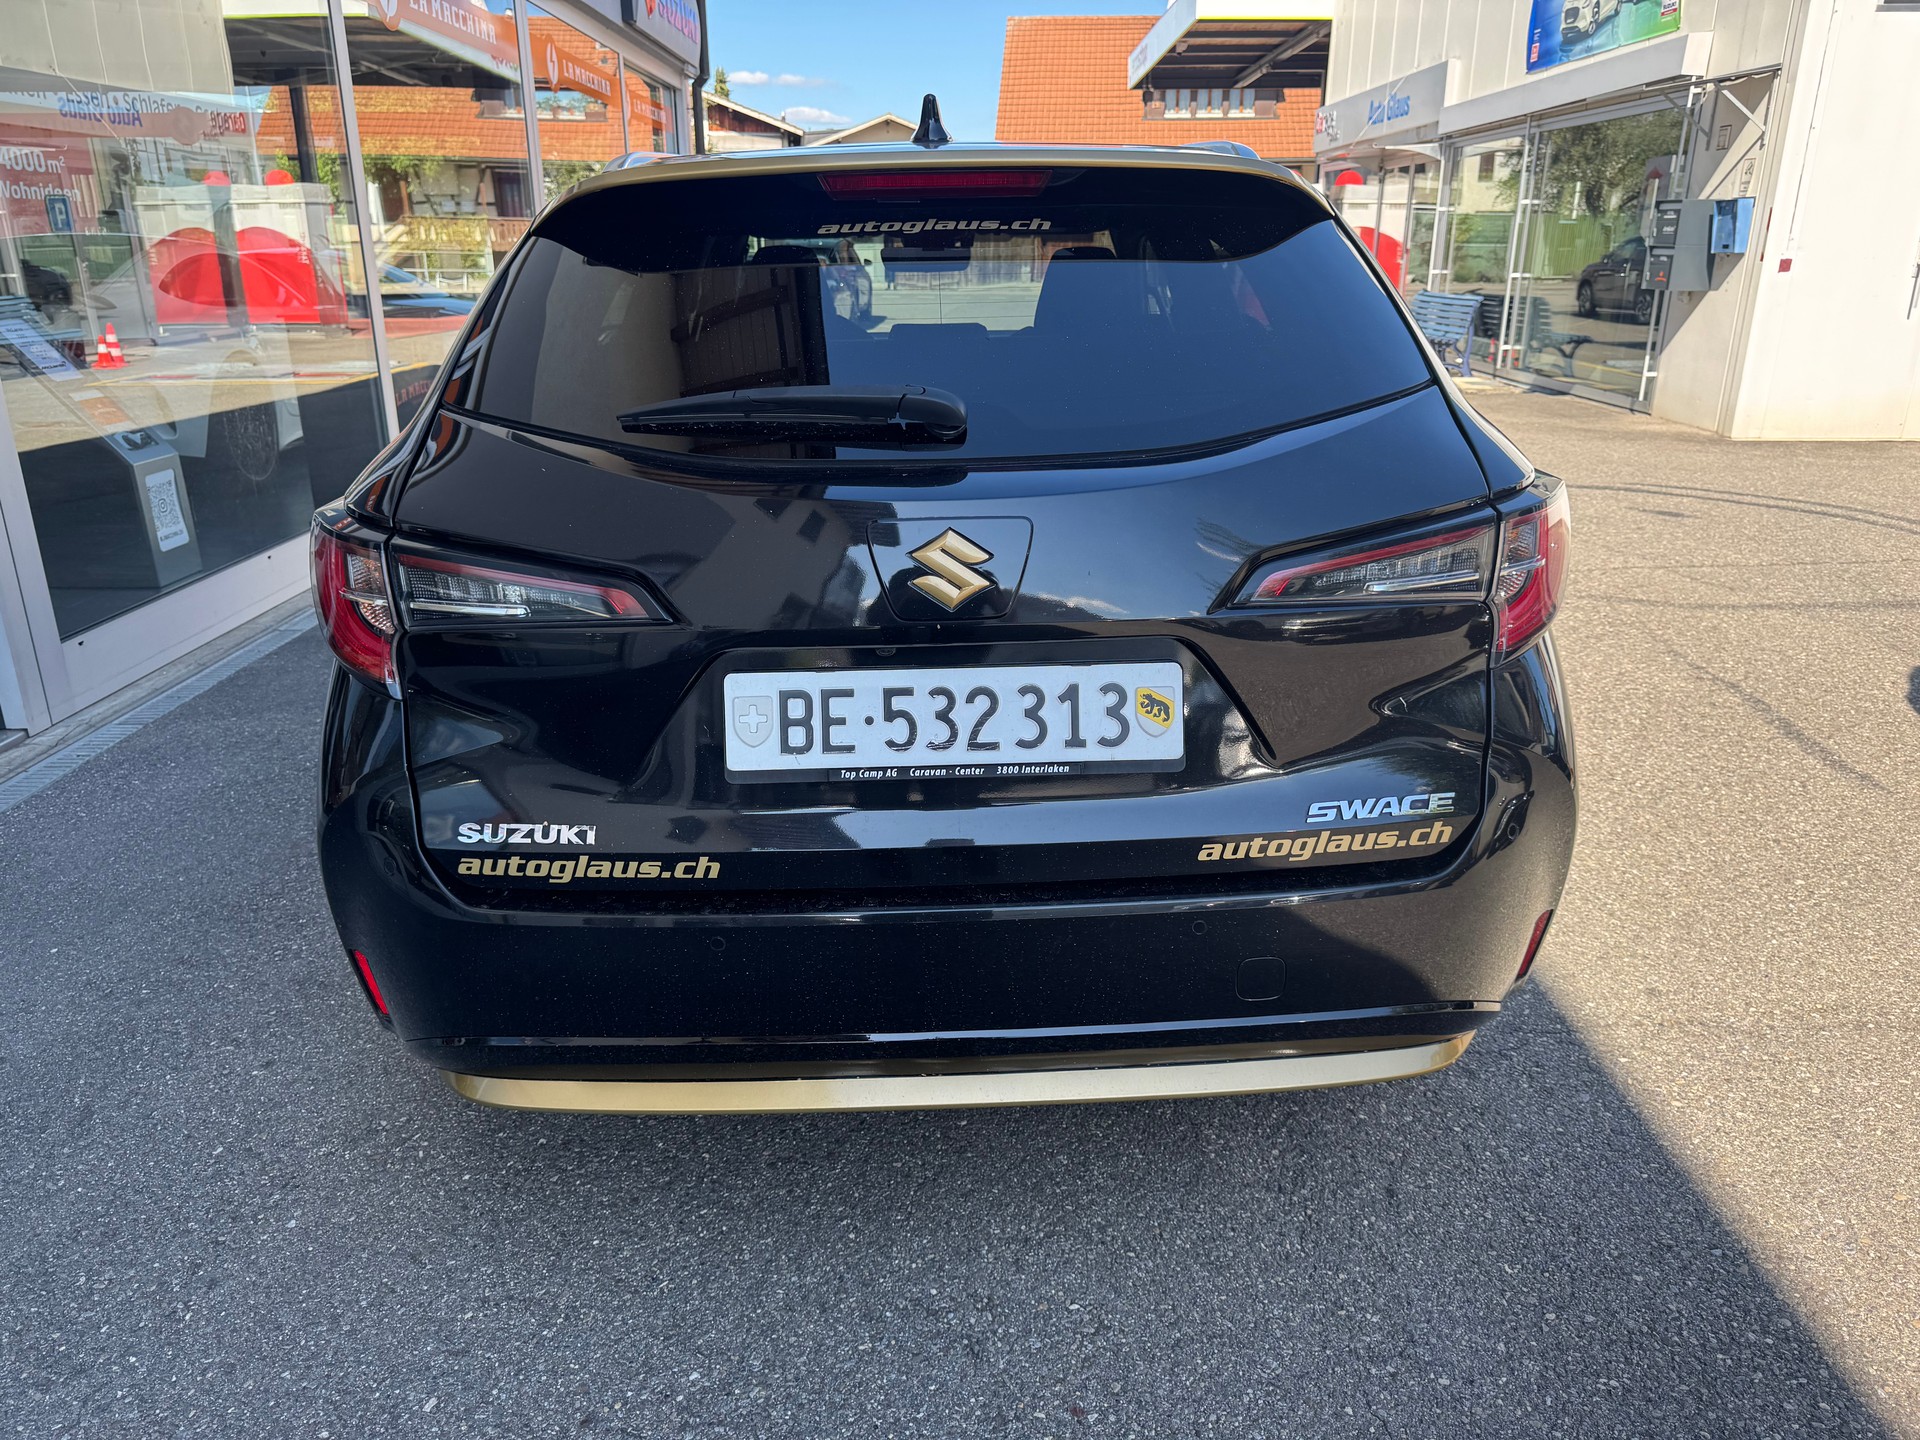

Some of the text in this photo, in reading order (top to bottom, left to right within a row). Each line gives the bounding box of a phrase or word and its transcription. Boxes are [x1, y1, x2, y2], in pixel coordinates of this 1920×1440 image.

[430, 0, 497, 45] MACCHINA
[562, 59, 611, 97] LA MACCHINA
[0, 148, 46, 173] 4000
[817, 218, 1052, 235] autoglaus.ch
[1015, 682, 1131, 750] 313
[840, 769, 856, 780] Top
[859, 768, 884, 780] Camp
[886, 768, 898, 778] AG
[910, 767, 946, 777] Caravan
[955, 765, 985, 776] Center
[997, 765, 1019, 775] 3800
[1021, 764, 1070, 775] Interlaken
[1305, 791, 1456, 824] SWACE
[457, 822, 597, 846] SUZUKI
[1197, 821, 1453, 862] autoglaus.ch
[457, 855, 721, 884] autoglaus.ch
